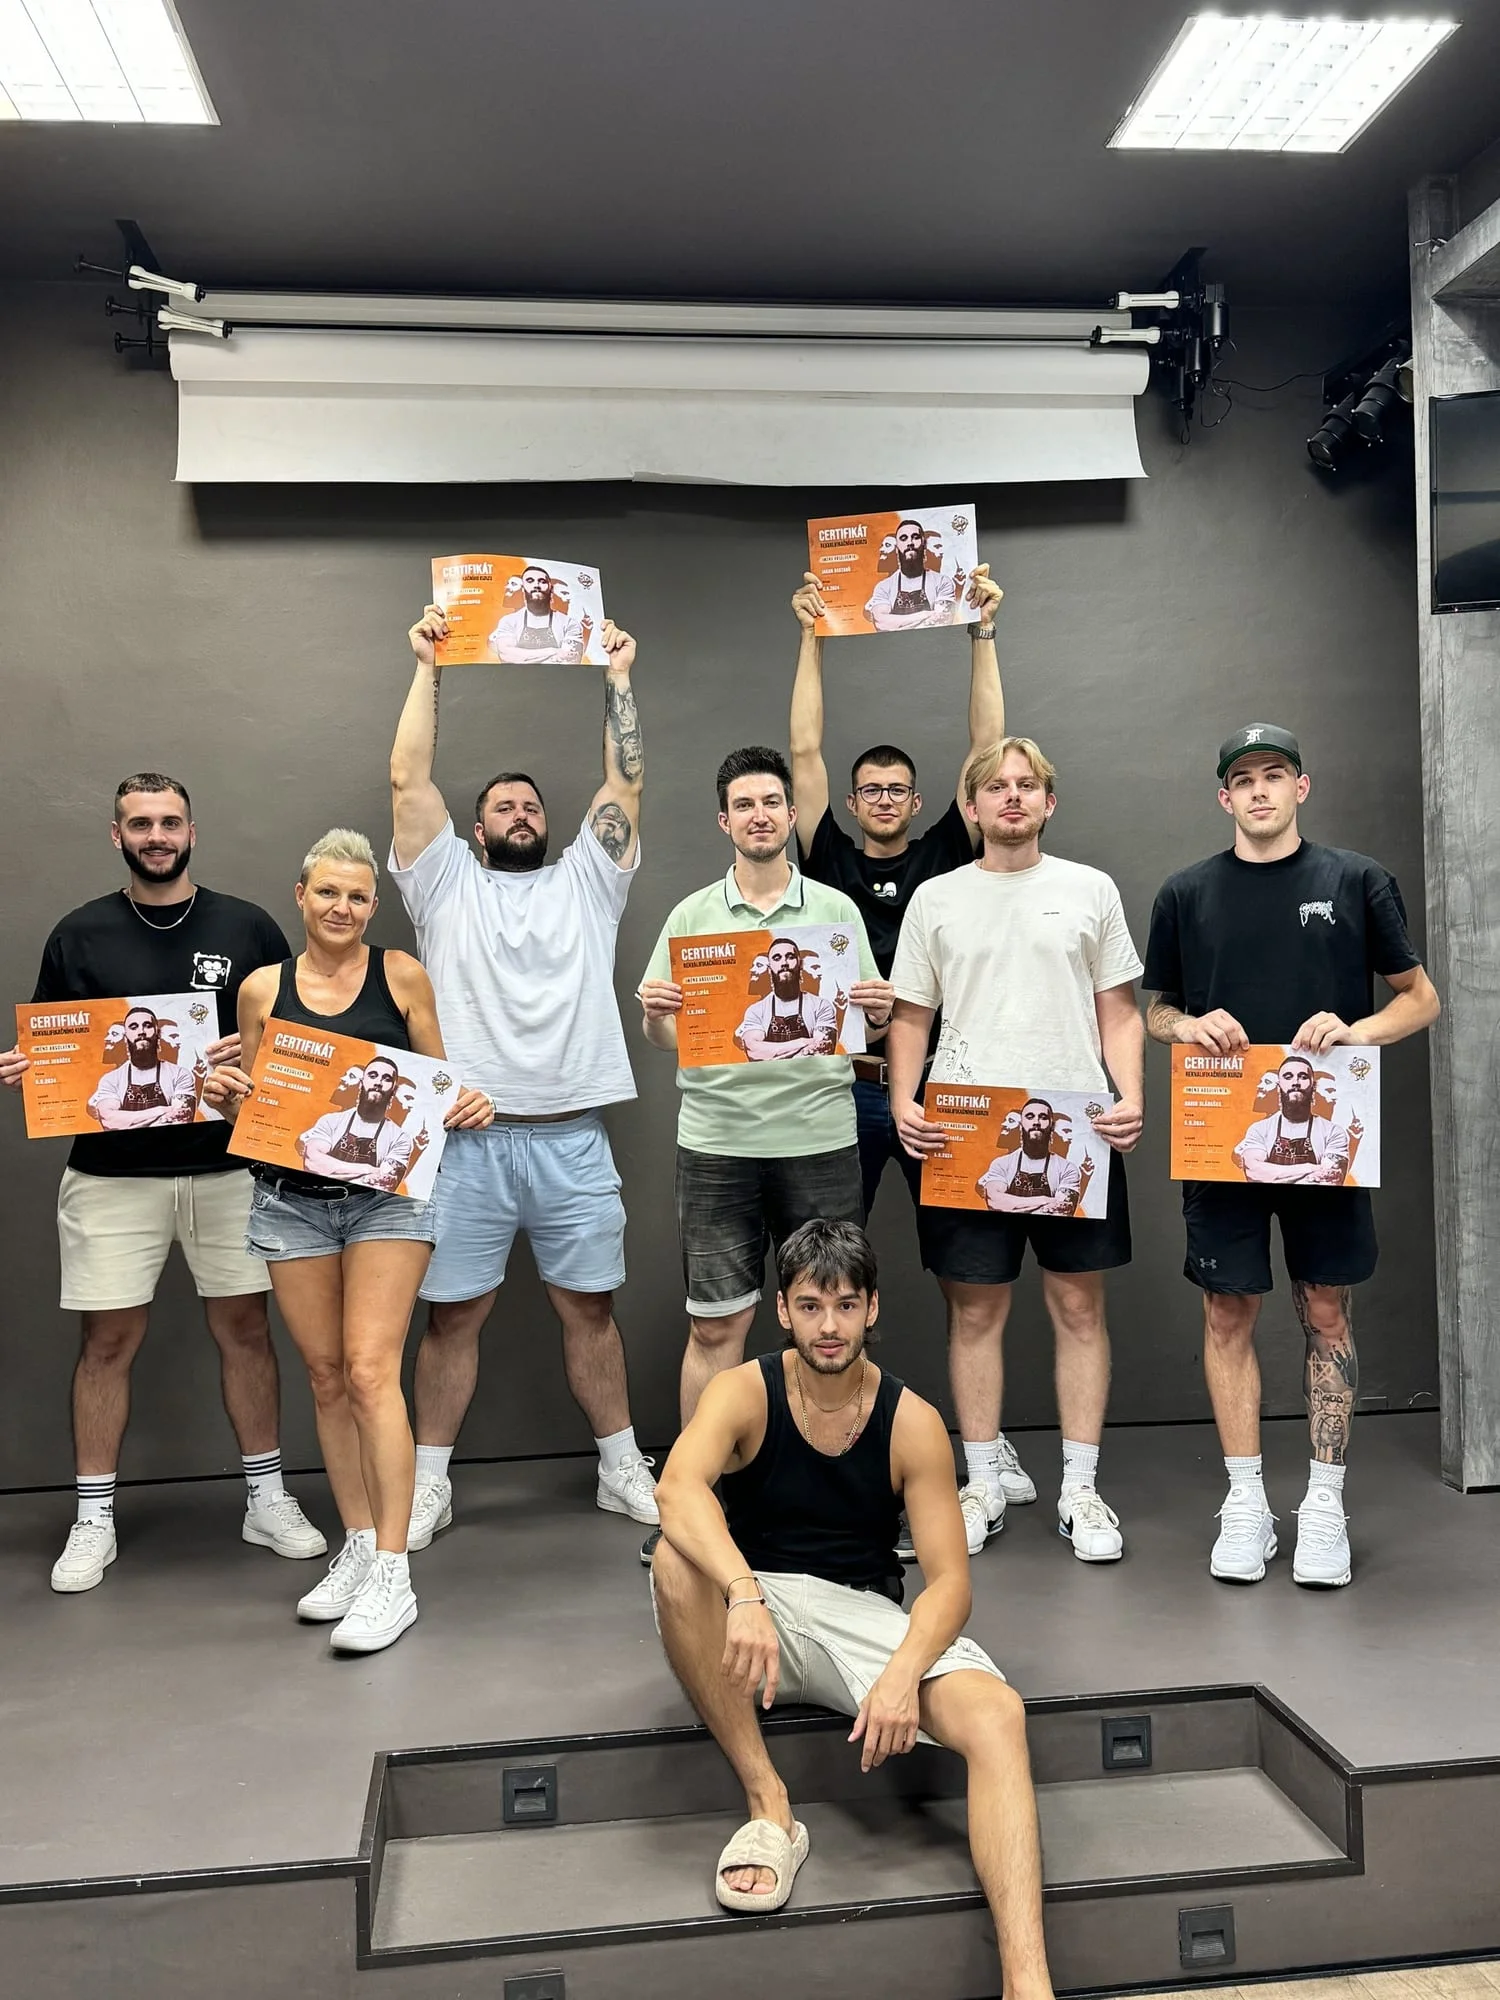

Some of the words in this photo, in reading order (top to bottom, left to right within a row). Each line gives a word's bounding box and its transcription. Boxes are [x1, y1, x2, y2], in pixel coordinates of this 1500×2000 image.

[818, 524, 868, 541] CERTIFIKÁT
[442, 562, 493, 577] CERTIFIKÁT
[681, 942, 737, 961] CERTIFIKÁT
[30, 1010, 91, 1029] CERTIFIKÁT
[274, 1032, 336, 1058] CERTIFIKÁT
[1184, 1054, 1245, 1070] CERTIFIKÁT
[936, 1094, 991, 1109] CERTIFIKÁT
